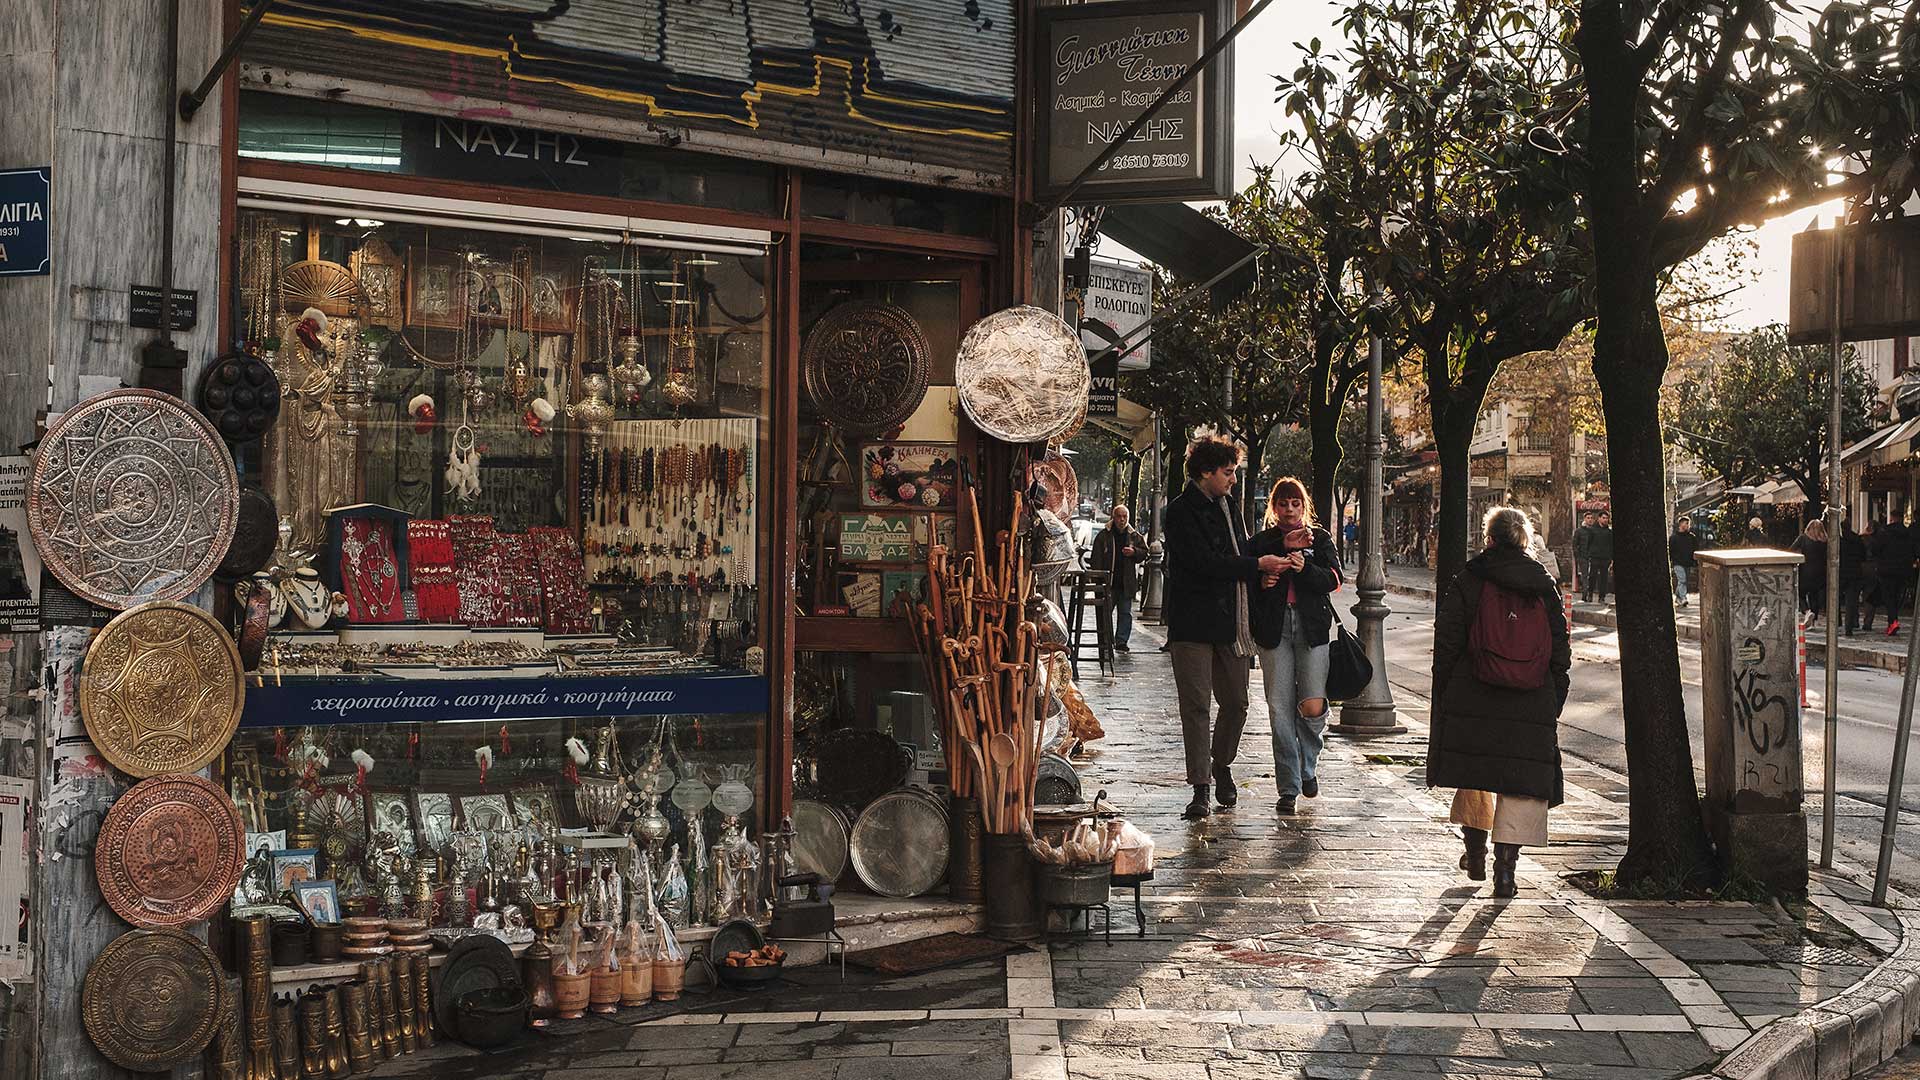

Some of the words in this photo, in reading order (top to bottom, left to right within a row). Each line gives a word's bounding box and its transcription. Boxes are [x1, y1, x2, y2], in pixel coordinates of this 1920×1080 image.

[1055, 27, 1190, 86] Γιαννιώτικη
[1117, 54, 1187, 83] Τέχνη
[1055, 90, 1105, 112] Ασημικά
[434, 118, 589, 167] ΝΑΣΗΣ
[1113, 155, 1150, 170] 26510
[1152, 153, 1190, 168] 73019
[1094, 295, 1147, 316] ΡΟΛΟΓΙΩΝ
[310, 689, 441, 718] χειροποίητα
[454, 686, 549, 713] ασημικά
[563, 686, 676, 711] κοσμήματα
